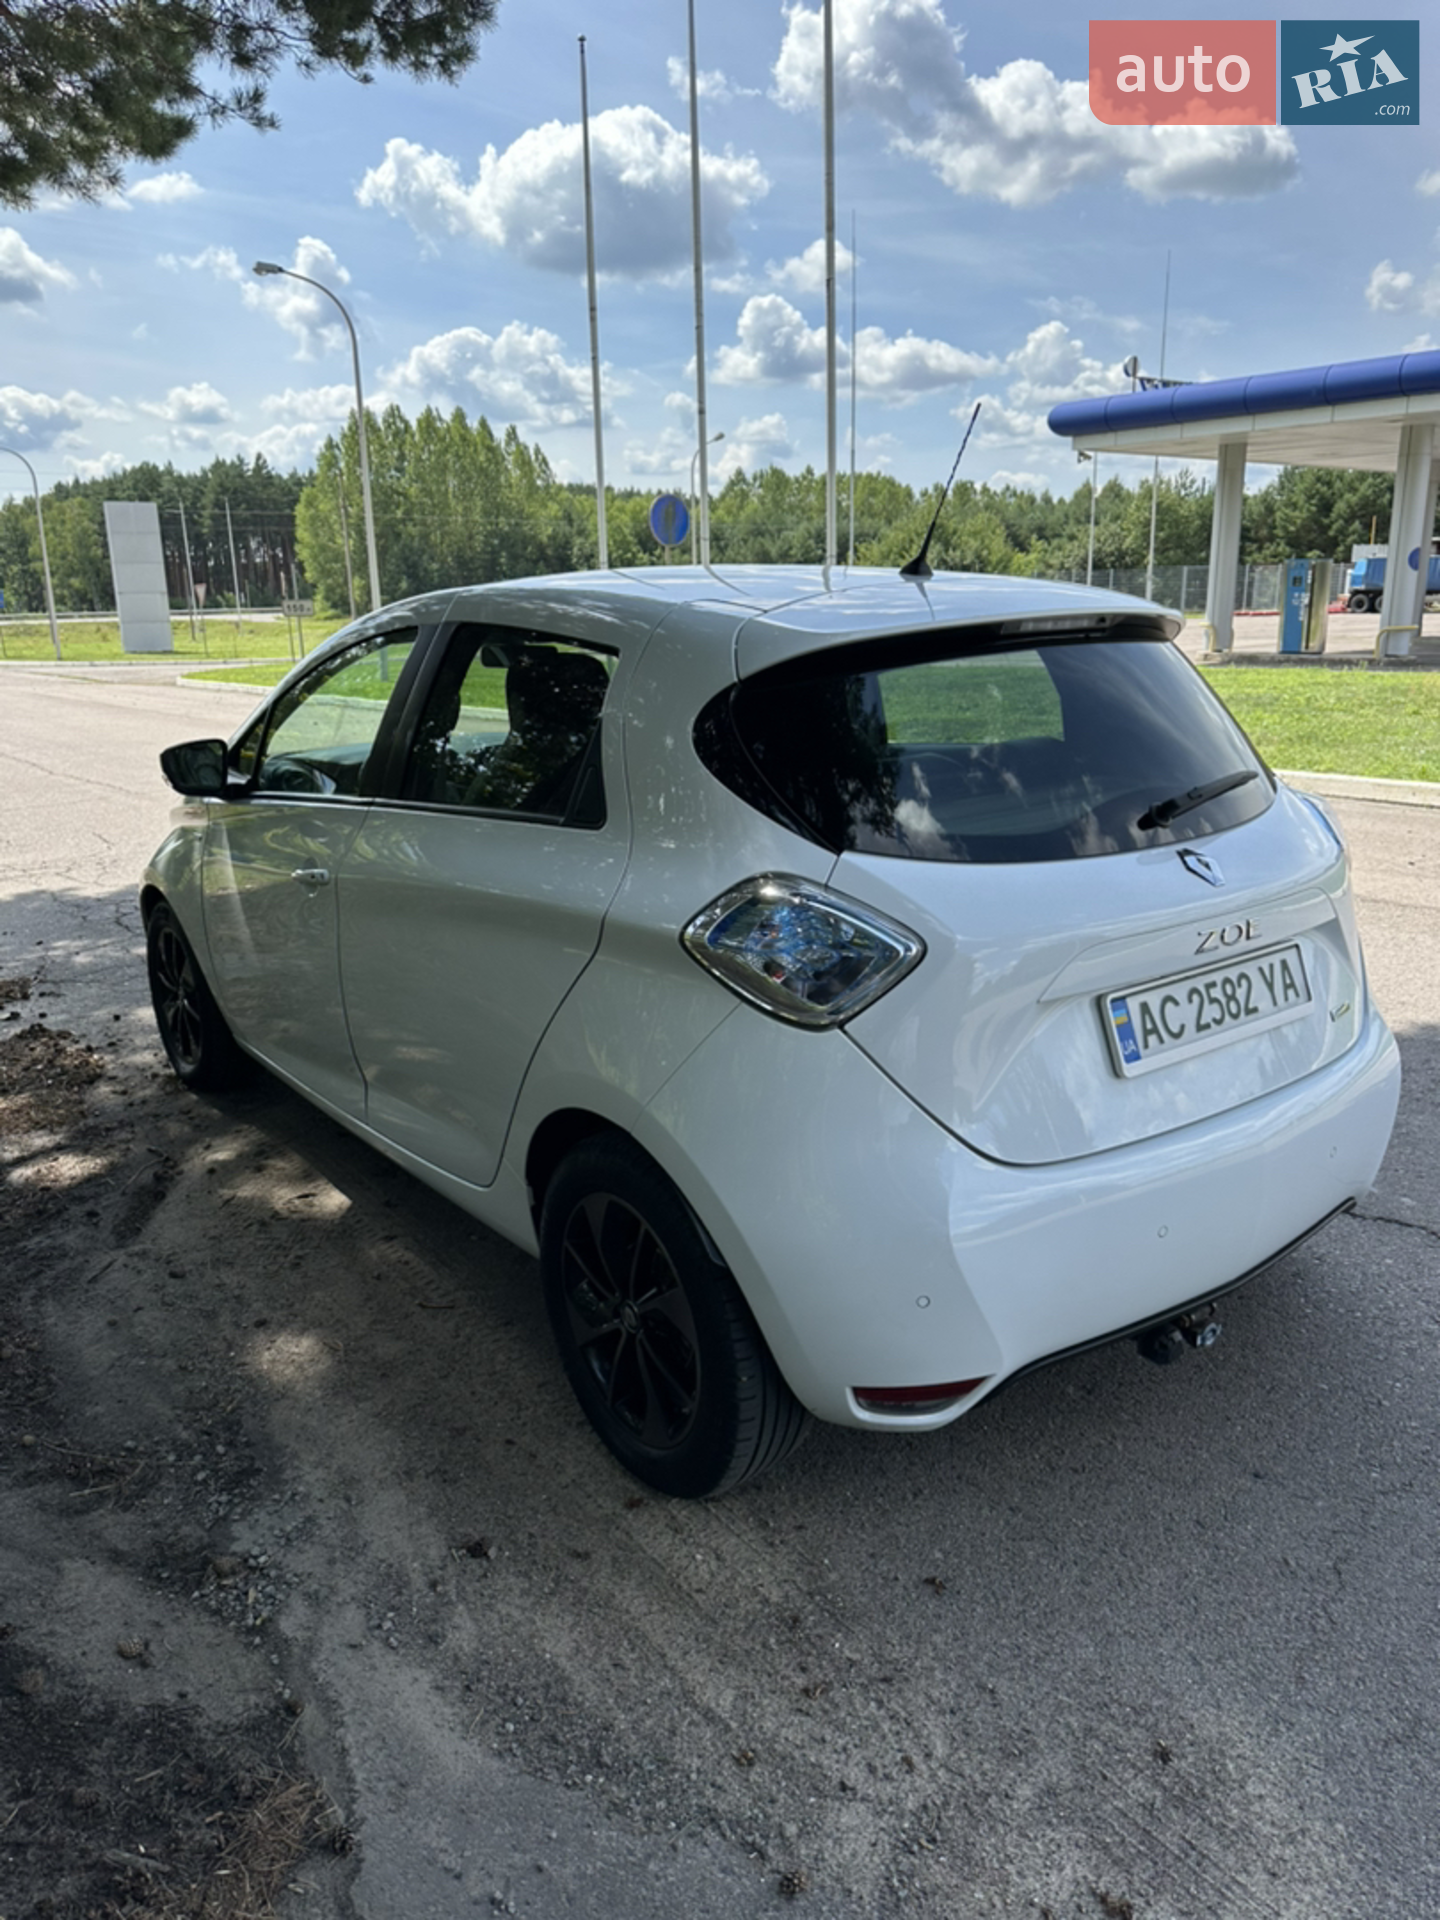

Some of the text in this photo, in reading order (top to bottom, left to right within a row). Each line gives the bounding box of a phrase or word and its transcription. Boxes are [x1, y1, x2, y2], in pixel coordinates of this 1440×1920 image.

[1194, 917, 1263, 955] ZOE
[1139, 958, 1300, 1050] AC 2582 YA
